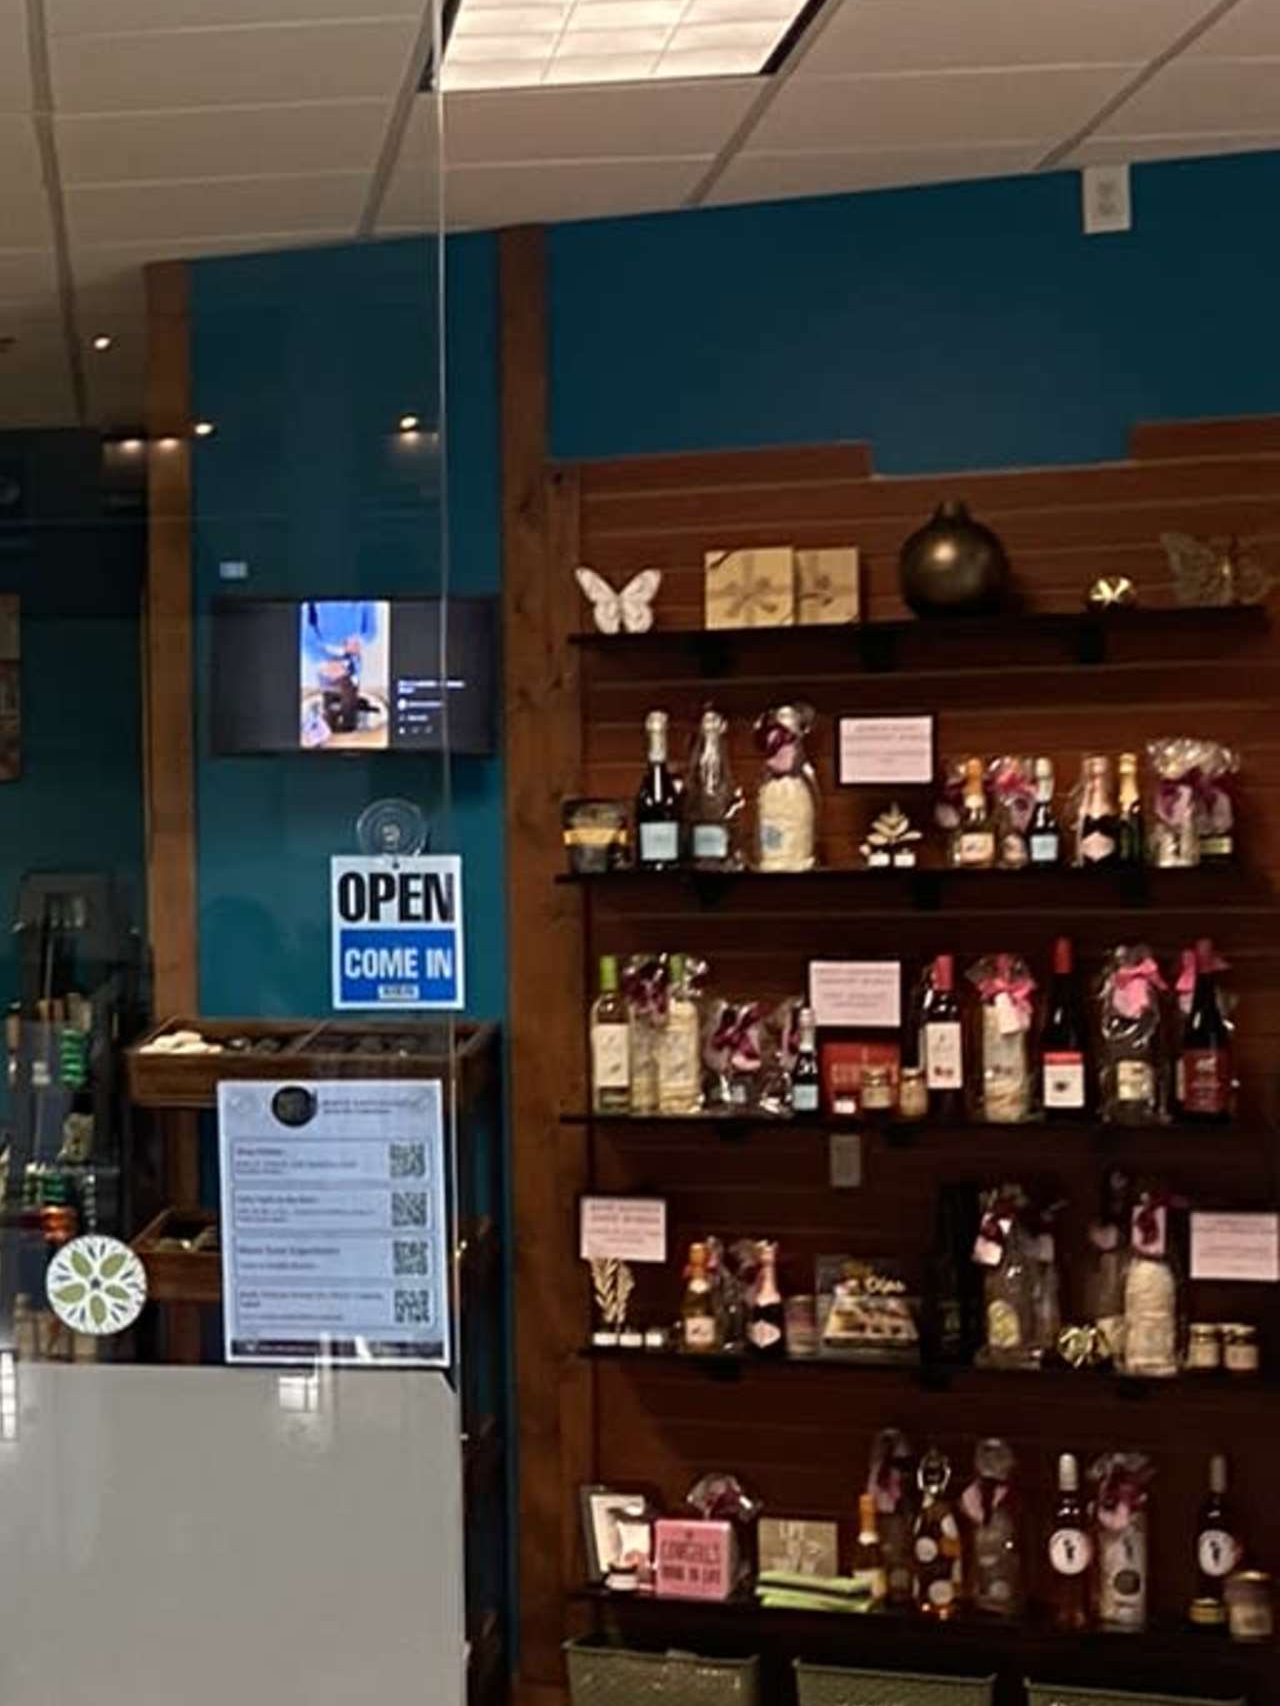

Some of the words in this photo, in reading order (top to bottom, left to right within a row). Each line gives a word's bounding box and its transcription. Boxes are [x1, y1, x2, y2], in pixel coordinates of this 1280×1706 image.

[338, 871, 455, 923] OPEN
[343, 946, 420, 980] COME
[425, 947, 453, 980] IN
